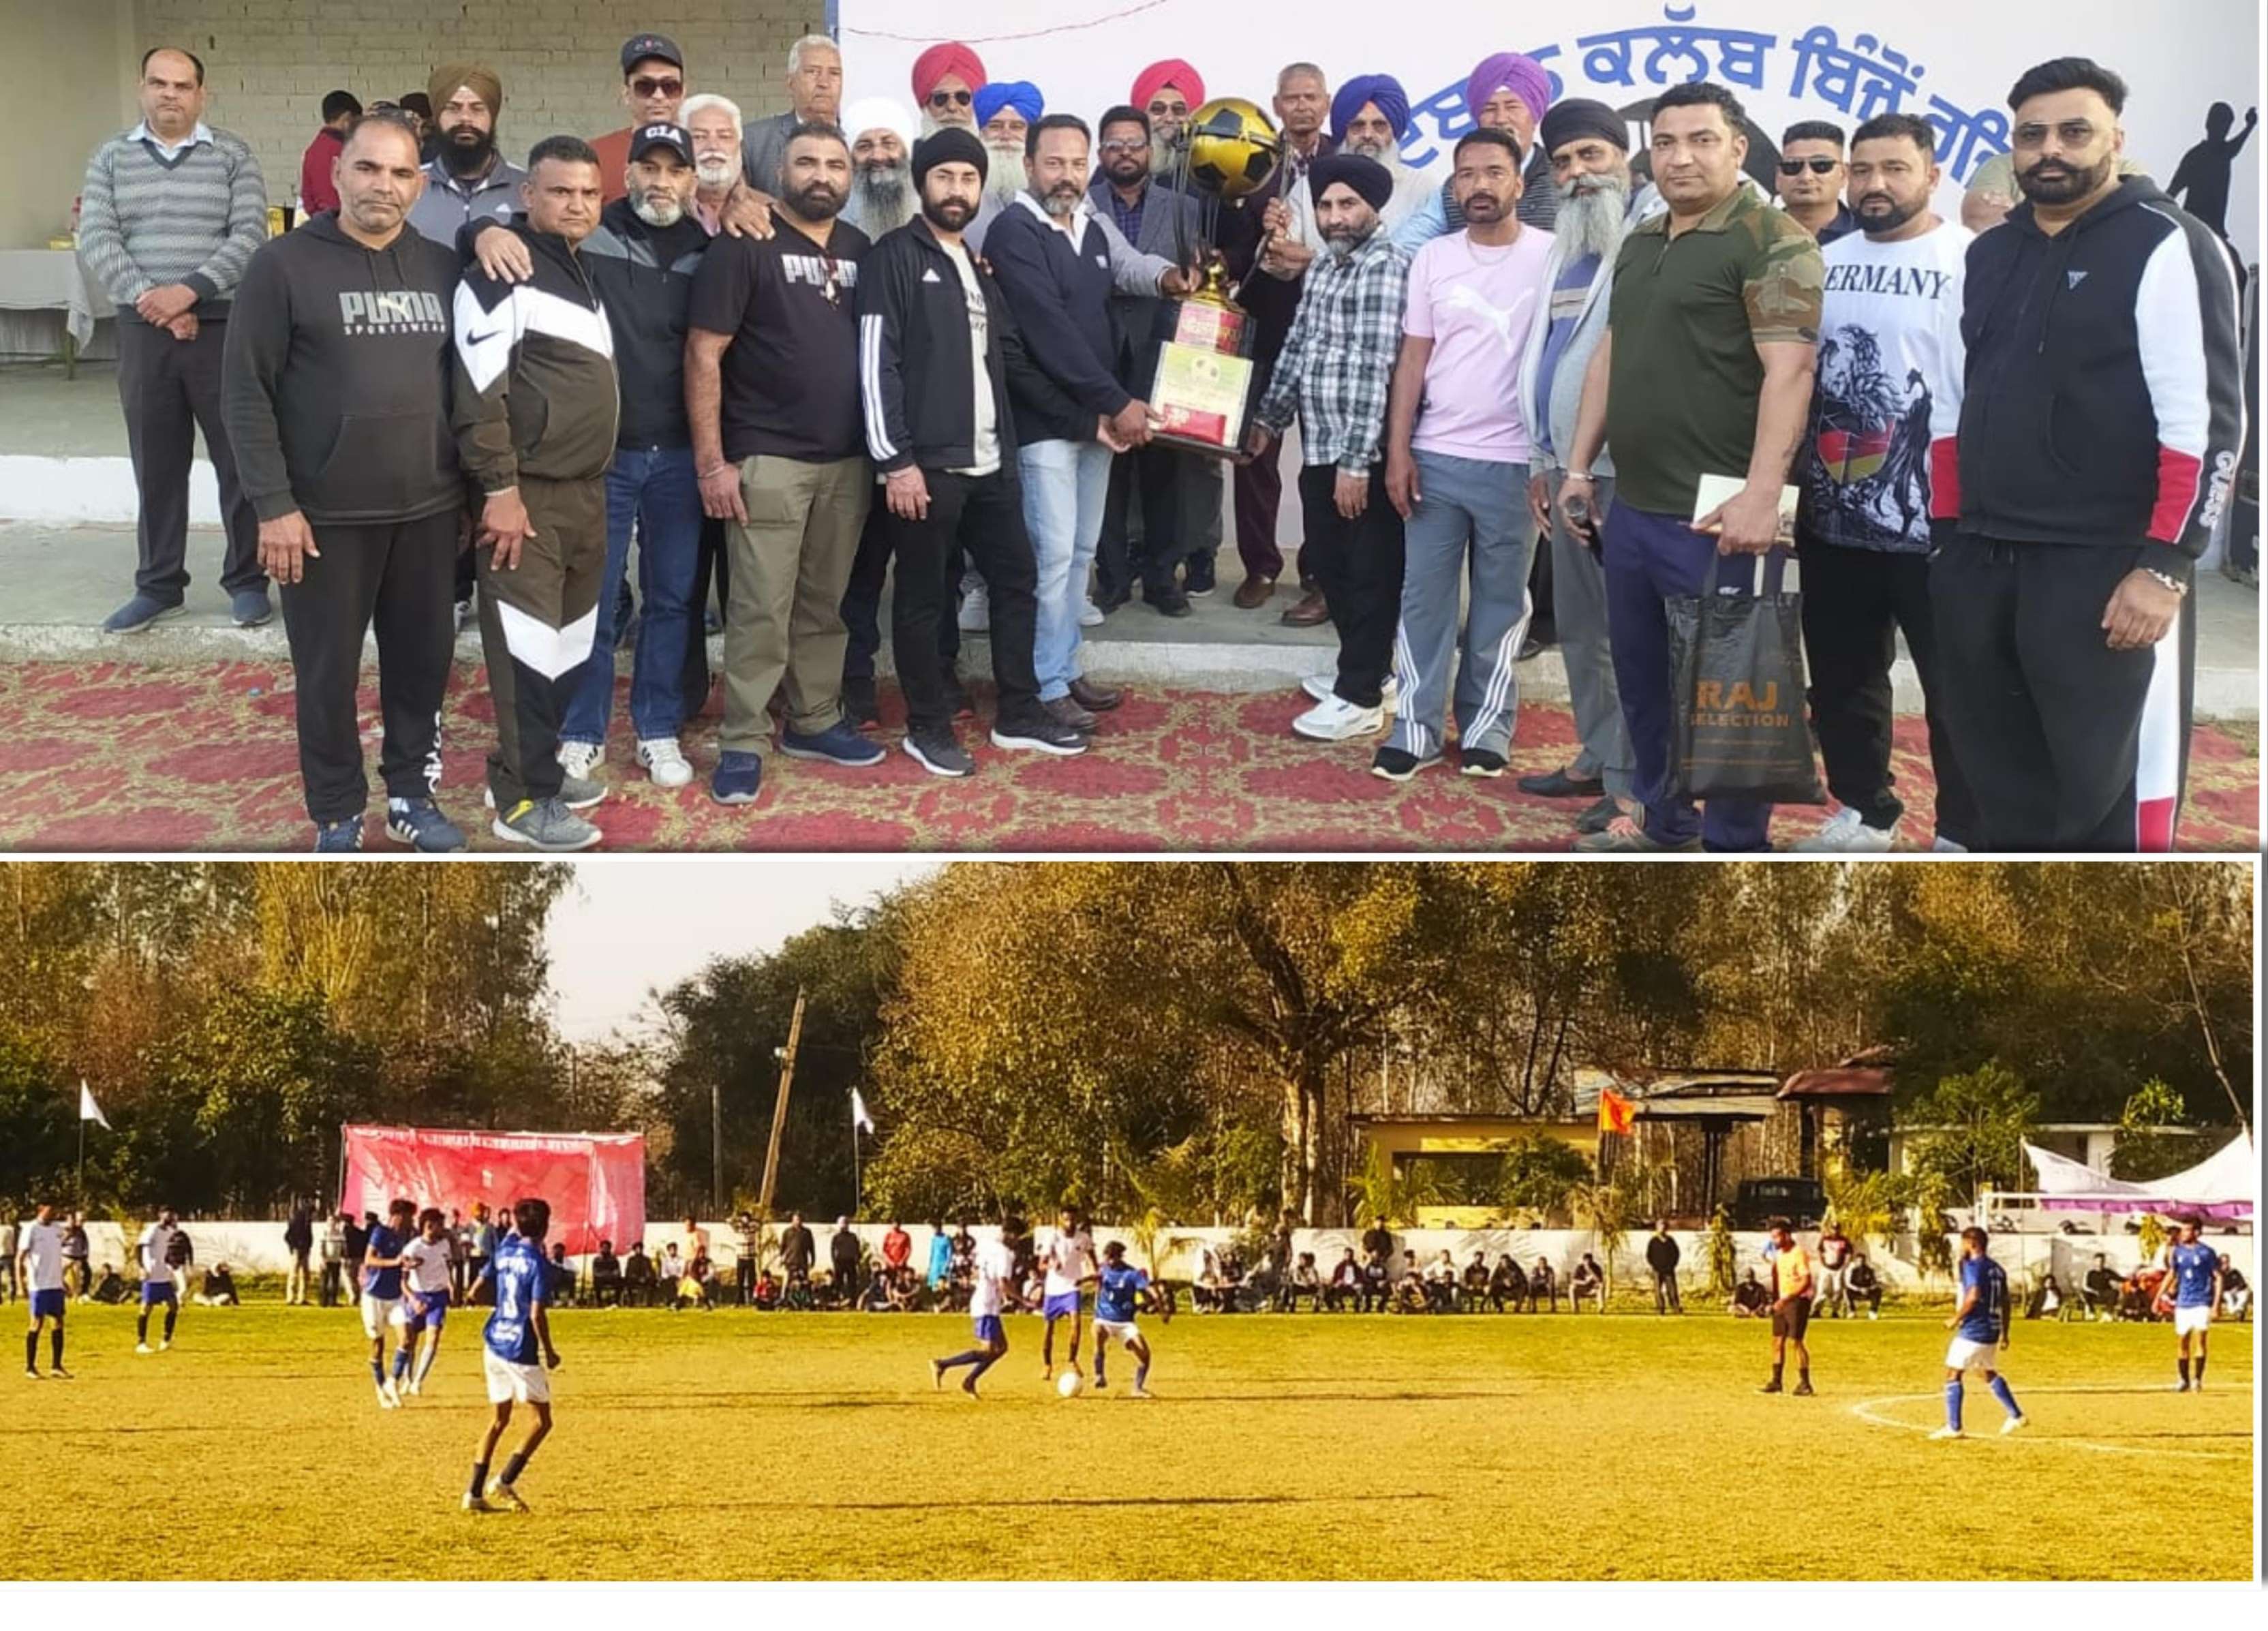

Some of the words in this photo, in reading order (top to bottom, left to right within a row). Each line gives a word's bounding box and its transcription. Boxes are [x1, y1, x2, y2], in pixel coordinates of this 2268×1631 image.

[1576, 3, 1777, 89] ਕਲੱਬ
[1823, 263, 1952, 300] ERMANY
[339, 292, 444, 324] PUMA
[1697, 680, 1777, 710] RAJ
